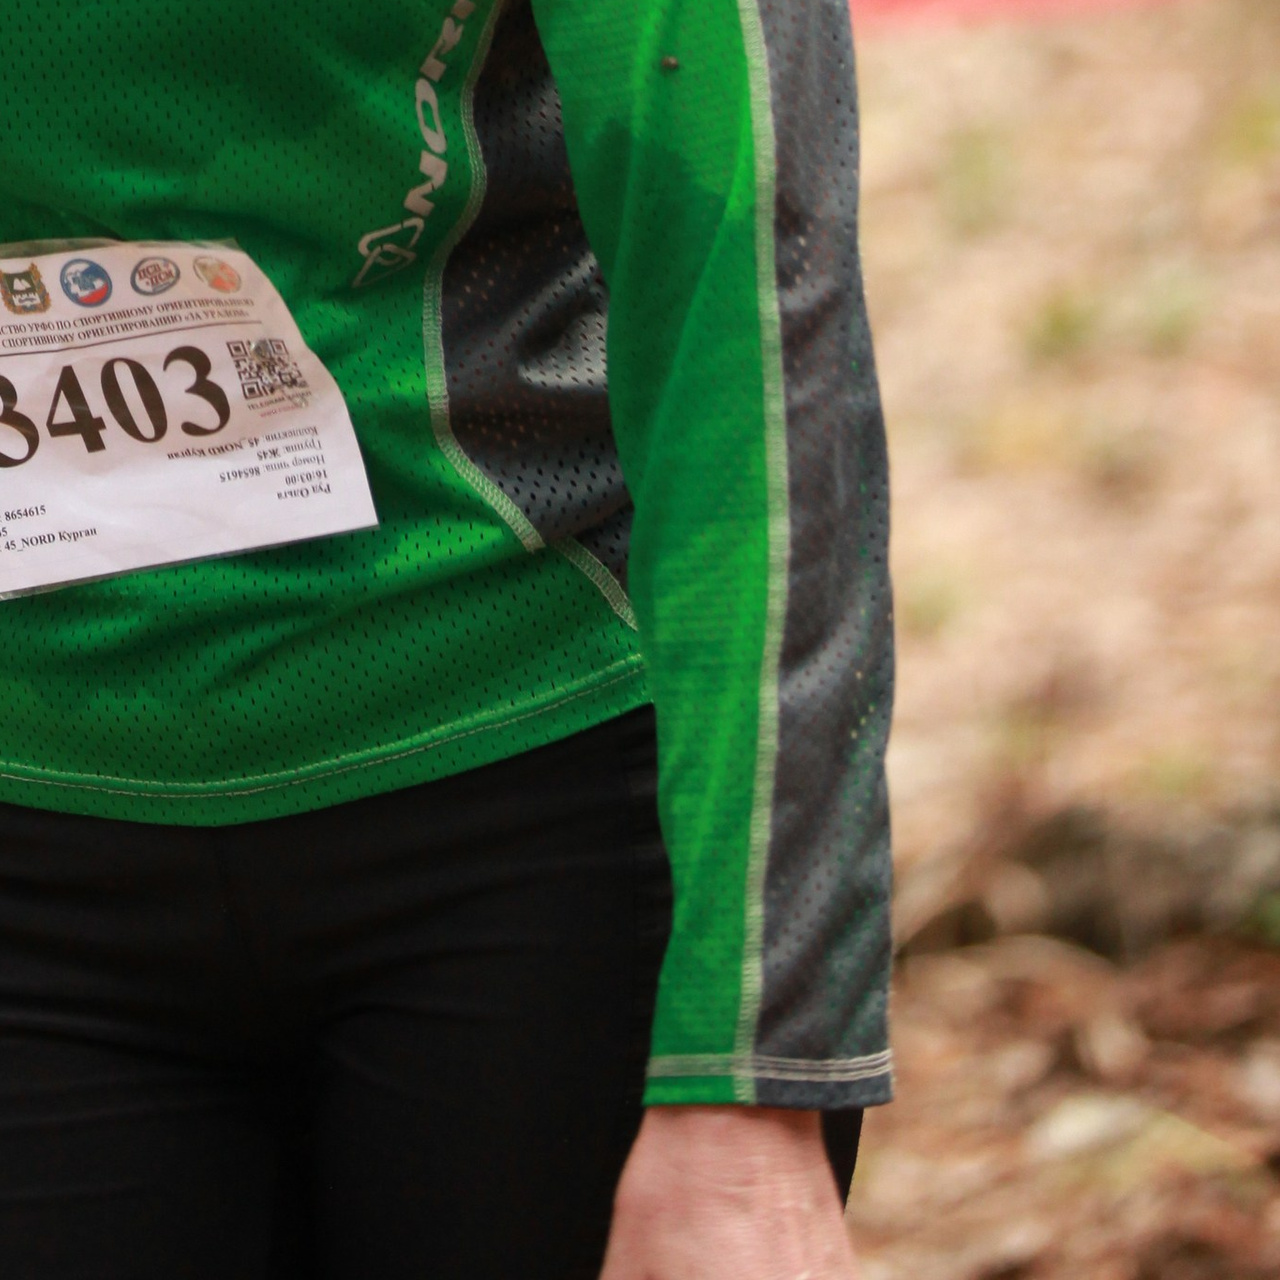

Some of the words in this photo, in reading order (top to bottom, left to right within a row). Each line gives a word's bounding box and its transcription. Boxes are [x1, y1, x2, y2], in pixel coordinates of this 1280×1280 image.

[28, 321, 55, 333] УРФО
[56, 319, 71, 331] ПО
[73, 304, 154, 328] СПОРТИВНОМУ
[2, 333, 73, 349] СПОРТИВНОМУ
[77, 313, 183, 340] ОРИЕНТИРОВАНИЮ
[265, 426, 319, 442] Коллектив:
[167, 447, 207, 461] Курган
[257, 447, 281, 461] Ж45
[283, 440, 322, 455] Группа:
[265, 460, 290, 473] чипа:
[291, 454, 326, 469] Номер
[219, 468, 261, 483] 8654615
[285, 469, 328, 486] 16:03:00
[277, 487, 310, 500] Ольга
[4, 505, 47, 522] 8654615
[4, 533, 56, 553] 45_NORD
[58, 527, 98, 542] Курган
